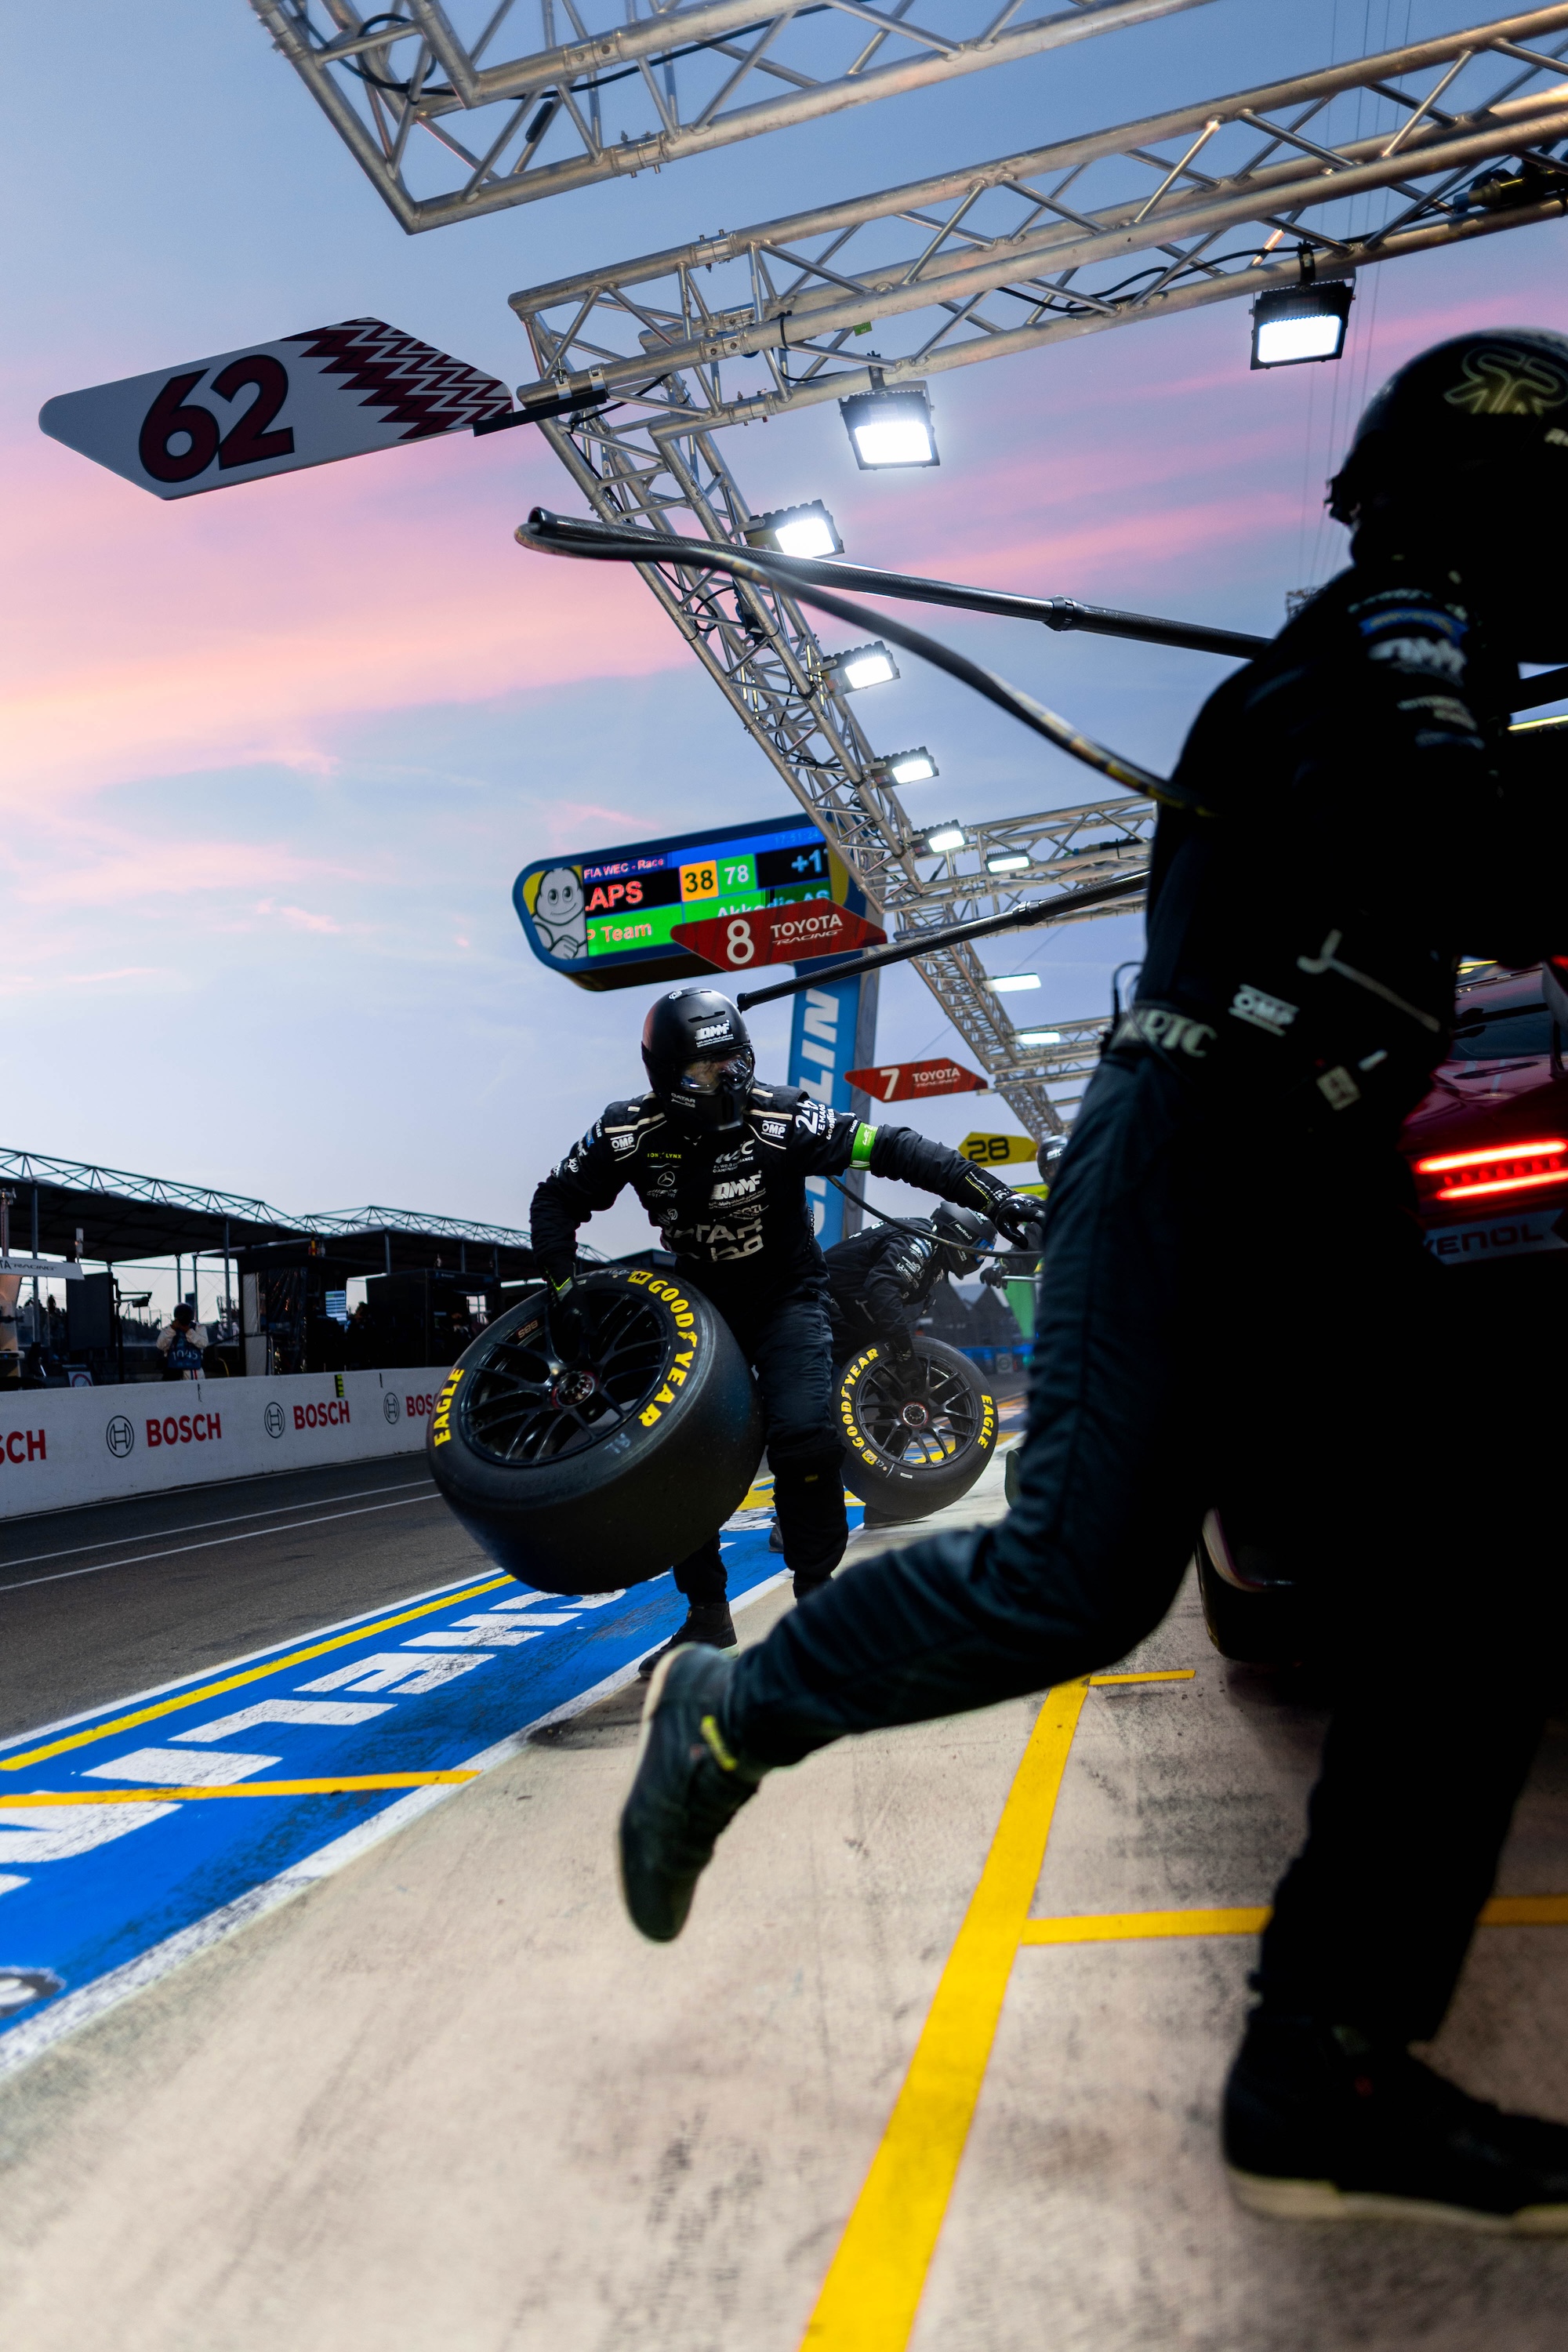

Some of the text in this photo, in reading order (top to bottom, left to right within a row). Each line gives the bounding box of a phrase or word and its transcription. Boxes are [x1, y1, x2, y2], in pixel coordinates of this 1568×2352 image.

[139, 354, 295, 483] 62
[583, 867, 602, 879] FIA
[603, 862, 628, 876] WEC
[637, 858, 664, 870] Race
[585, 881, 643, 911] APS
[684, 869, 713, 893] 38
[724, 865, 749, 885] 78
[601, 923, 652, 942] Team
[727, 913, 843, 965] 8 TOYOTA
[772, 929, 843, 946] RACING
[880, 1068, 960, 1100] 7 TOYOTA
[612, 1135, 634, 1149] OMP
[762, 1123, 786, 1136] OMP
[967, 1136, 1010, 1163] 28
[638, 1279, 698, 1427] GOODYEAR
[146, 1412, 222, 1448] BOSCH
[293, 1400, 350, 1430] BOSCH
[406, 1393, 437, 1417] BOS
[434, 1367, 465, 1447] EAGLE
[840, 1348, 879, 1448] GOODYEAR
[977, 1395, 993, 1449] EAGLE
